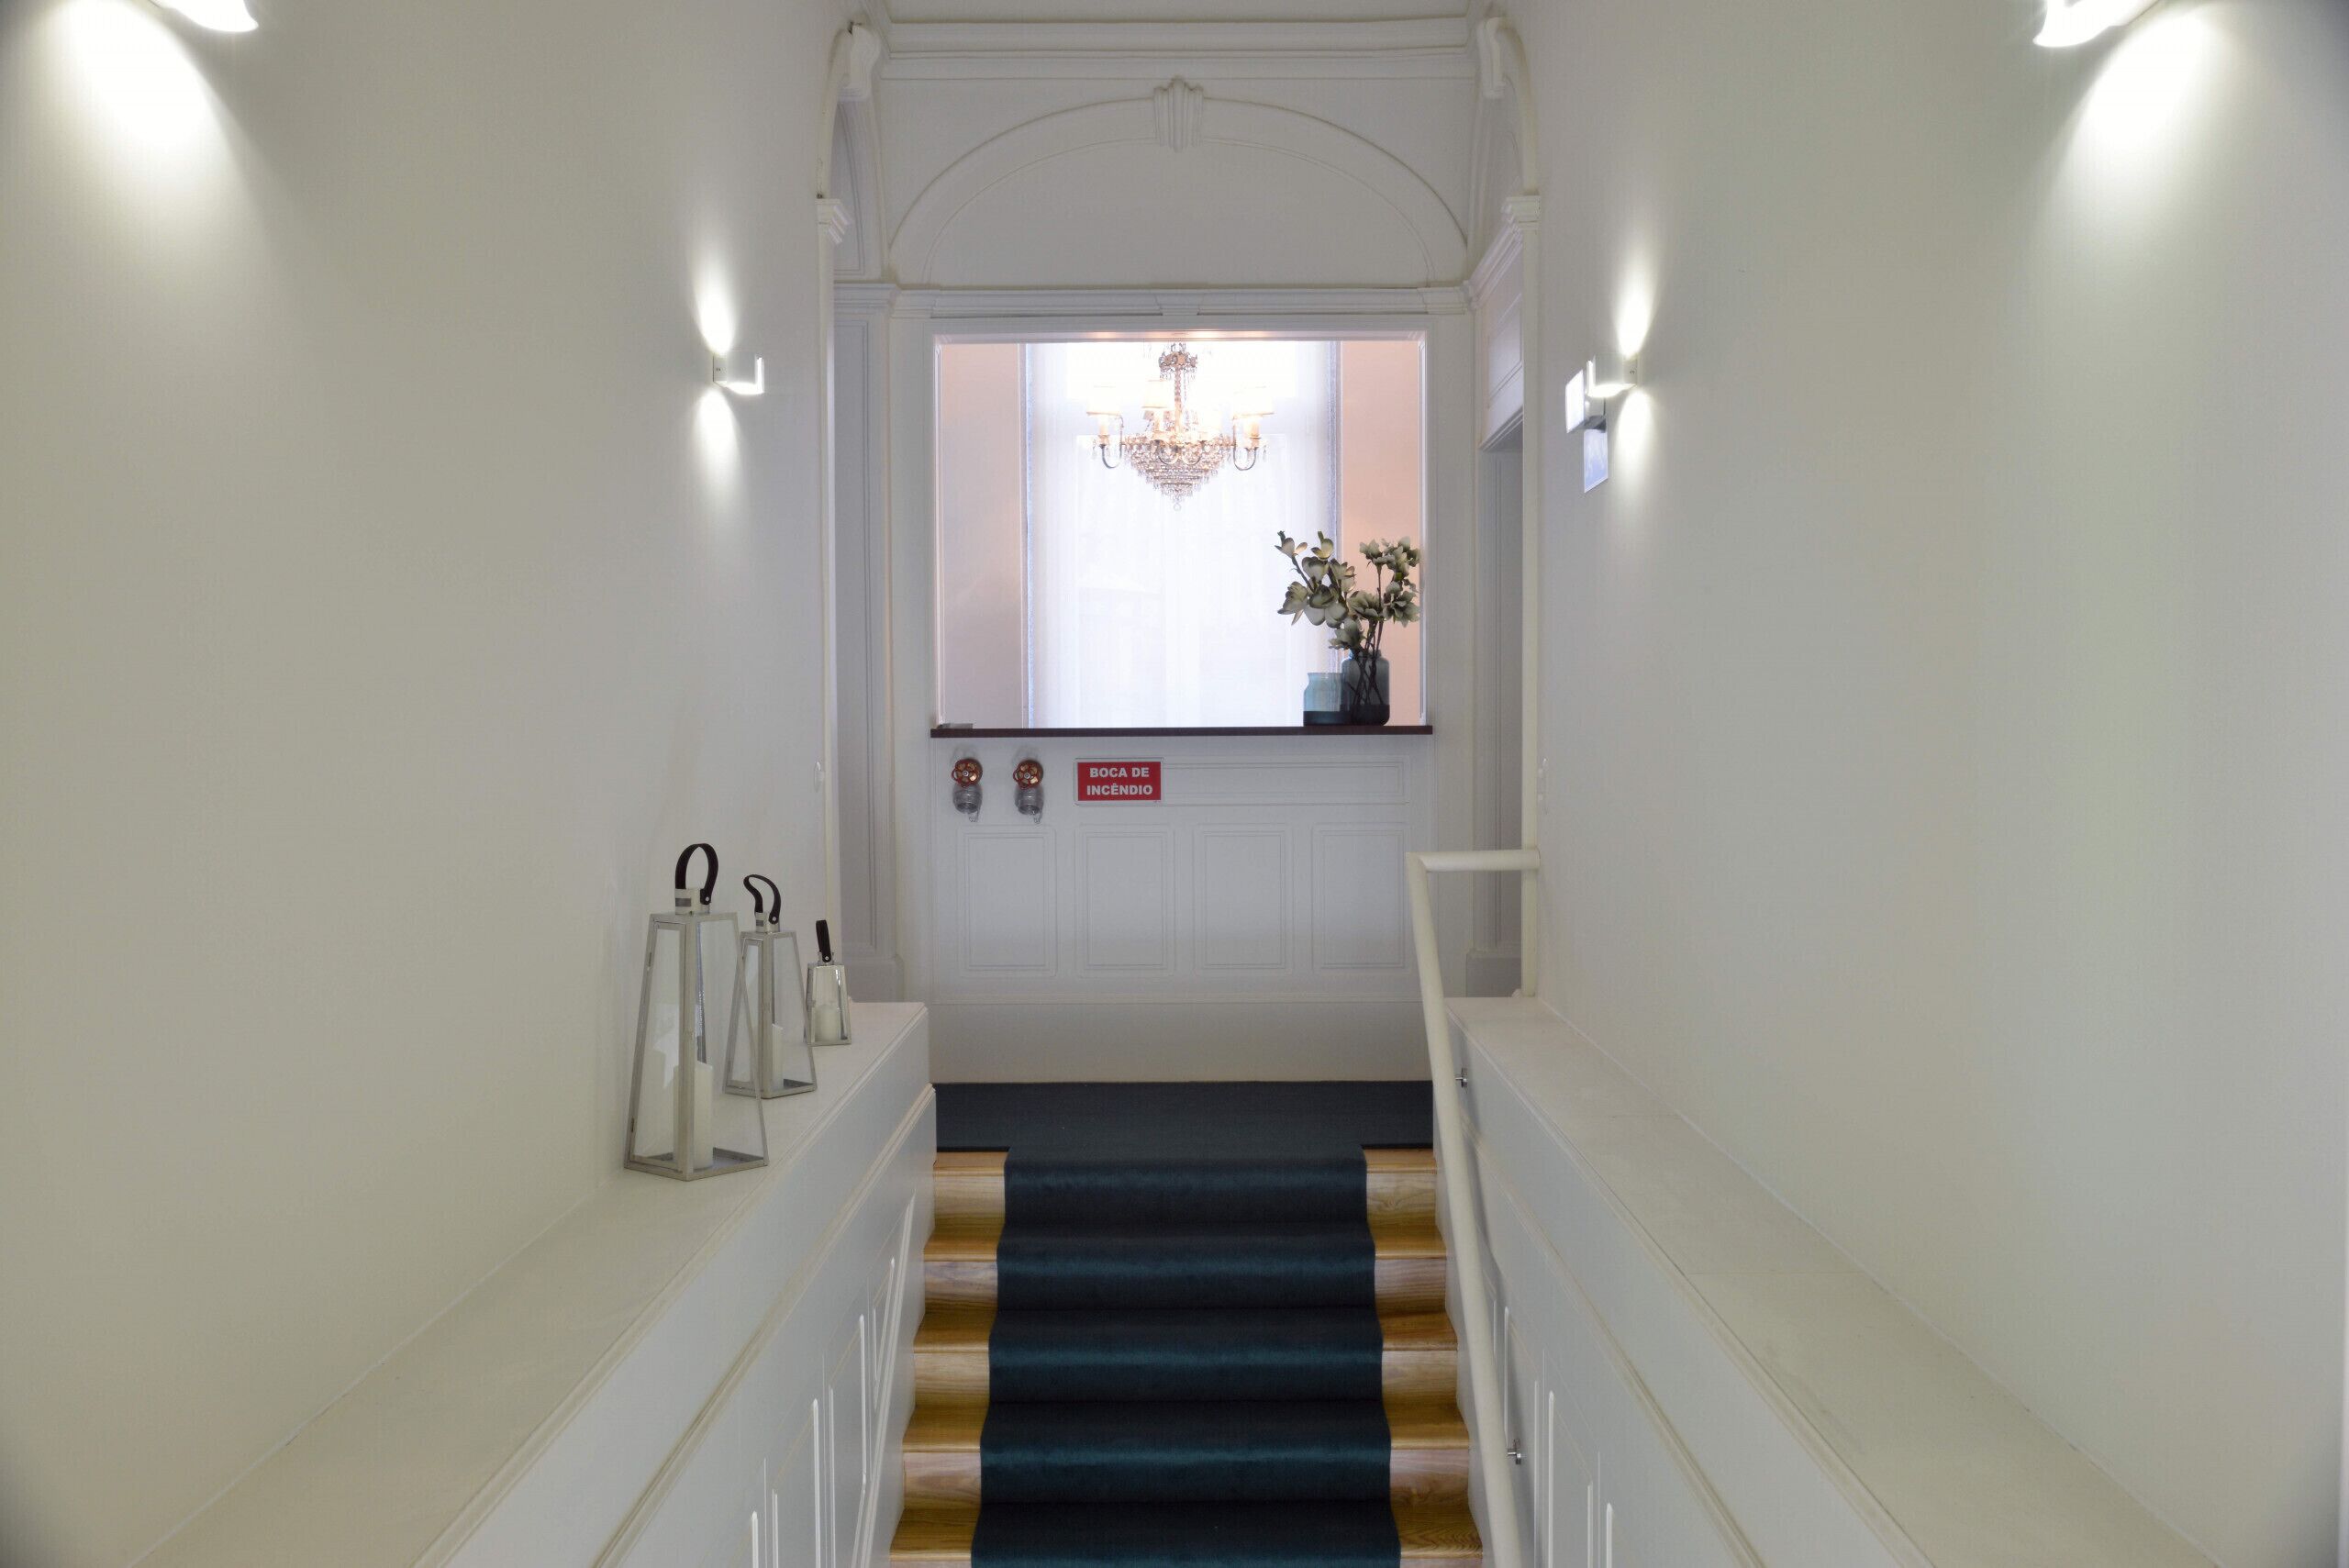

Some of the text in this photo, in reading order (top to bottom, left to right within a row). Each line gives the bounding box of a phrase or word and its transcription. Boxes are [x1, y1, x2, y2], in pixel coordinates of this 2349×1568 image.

[1089, 767, 1150, 778] BOCA DE
[1086, 783, 1153, 795] INCÊNDIO
